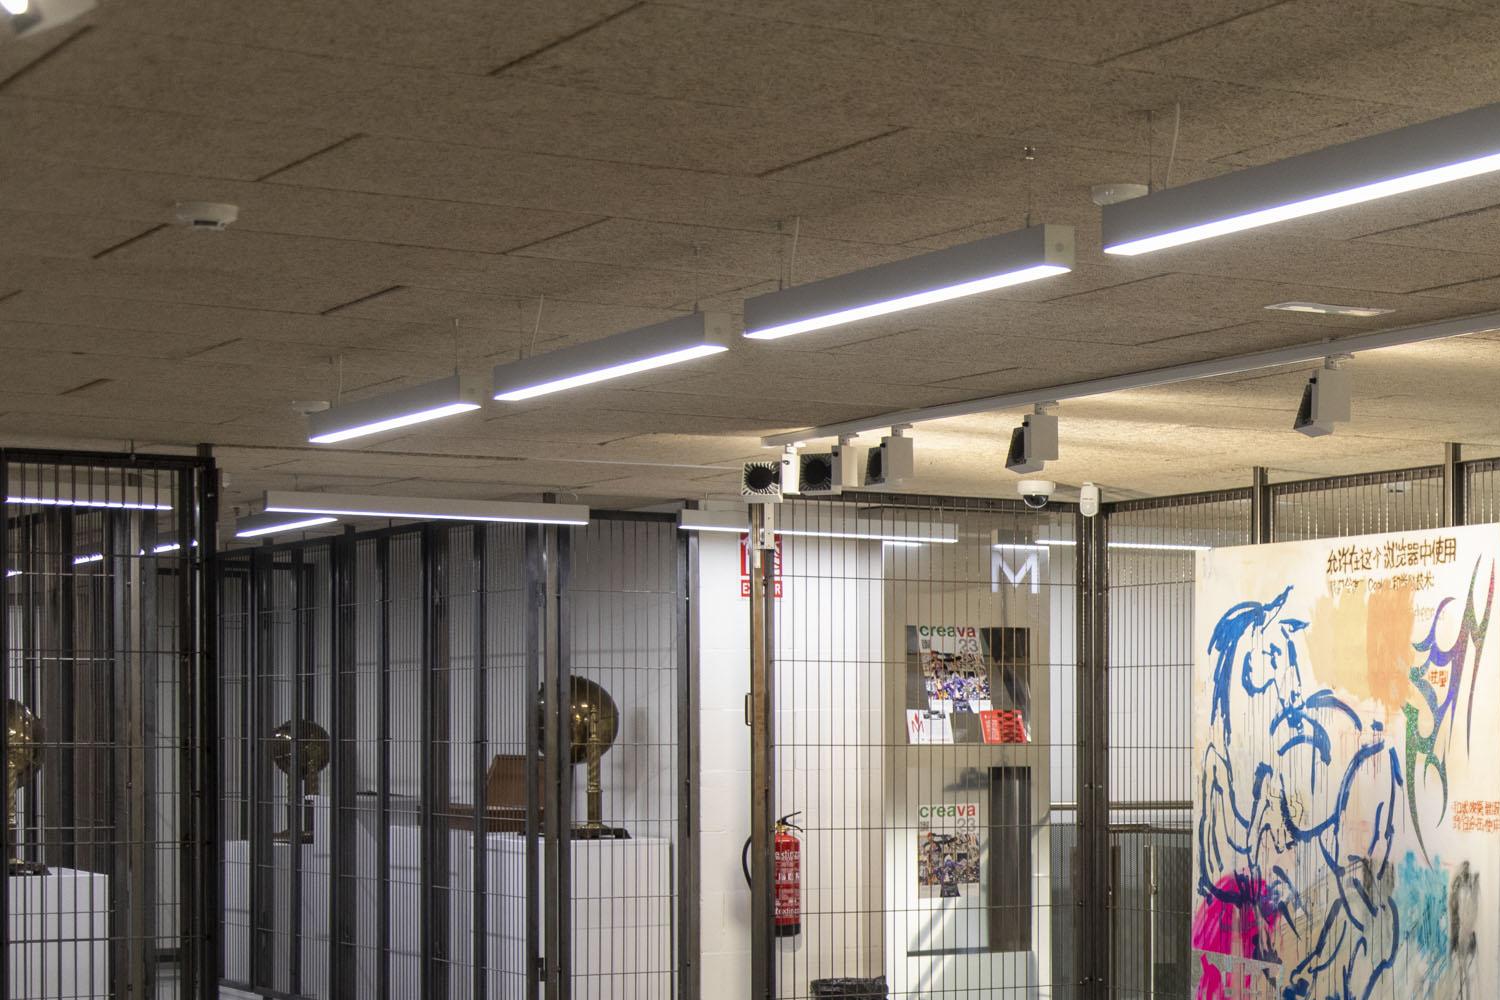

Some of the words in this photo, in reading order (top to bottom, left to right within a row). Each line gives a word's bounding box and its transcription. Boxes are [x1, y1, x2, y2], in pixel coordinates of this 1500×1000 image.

[991, 548, 1038, 594] M
[919, 625, 977, 638] creava
[959, 639, 978, 652] 23
[919, 804, 976, 818] creava
[957, 818, 977, 832] 23
